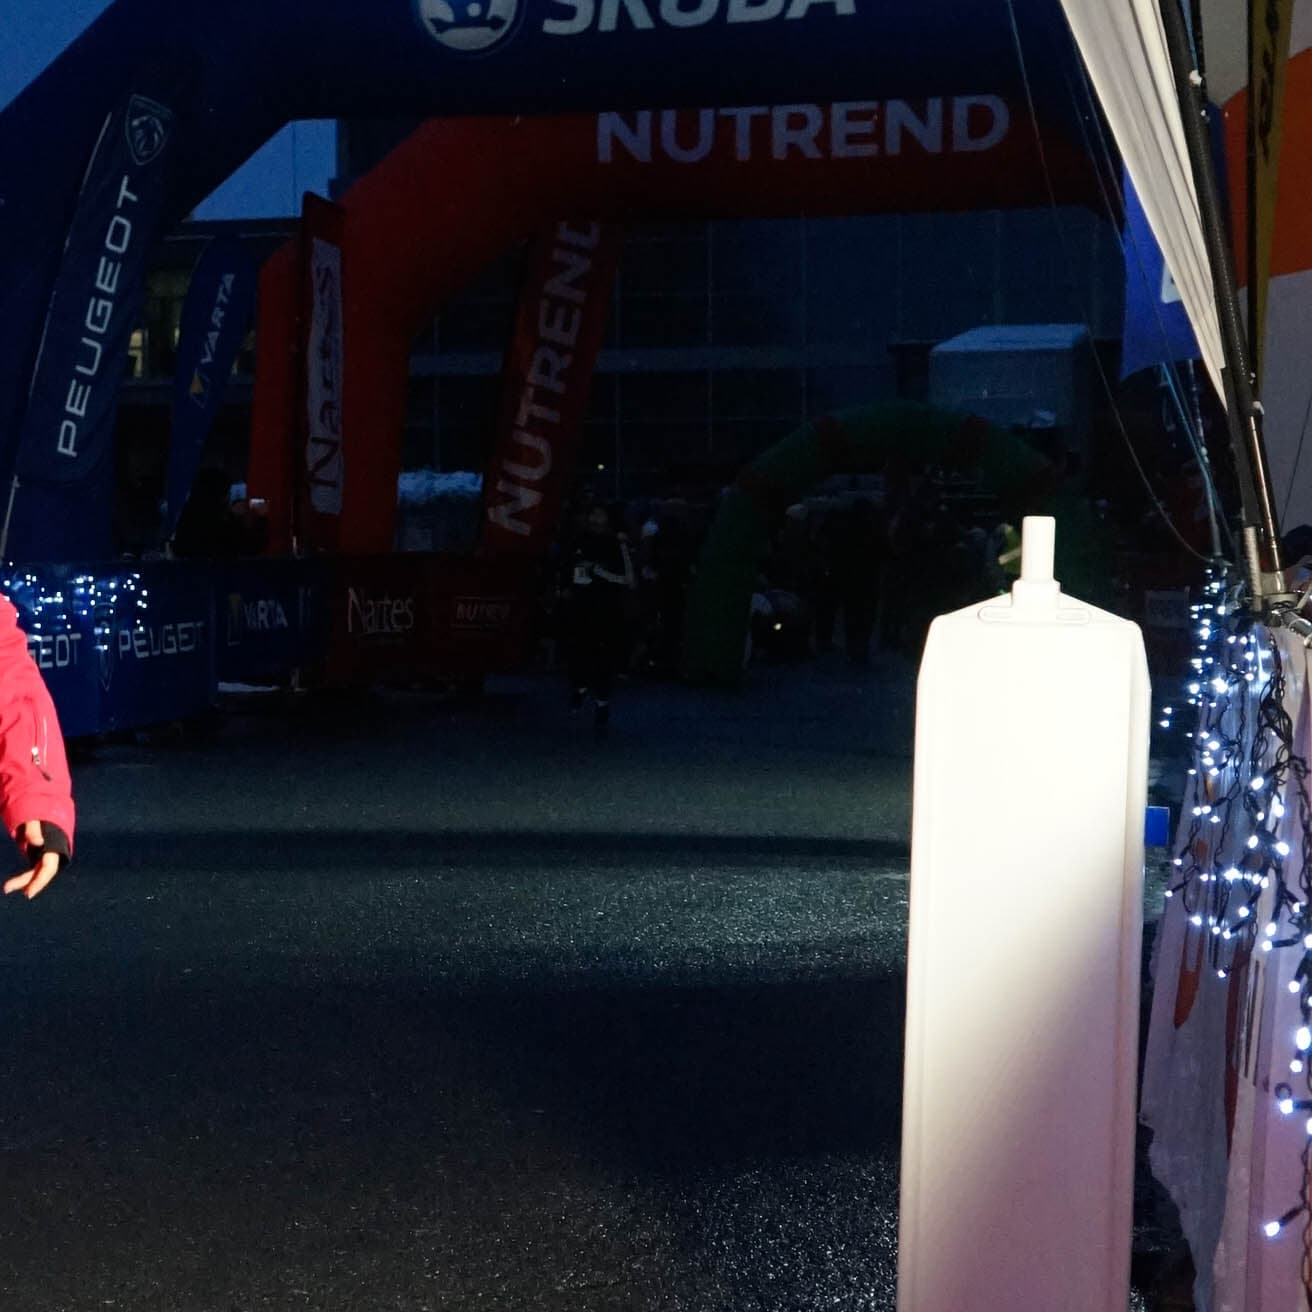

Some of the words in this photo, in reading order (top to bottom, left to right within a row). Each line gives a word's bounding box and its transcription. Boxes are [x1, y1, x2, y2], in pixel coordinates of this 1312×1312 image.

[596, 94, 1010, 164] NUTREND
[57, 174, 140, 458] PEUGEOT
[199, 272, 236, 365] VARTA
[119, 620, 205, 661] PEUGET
